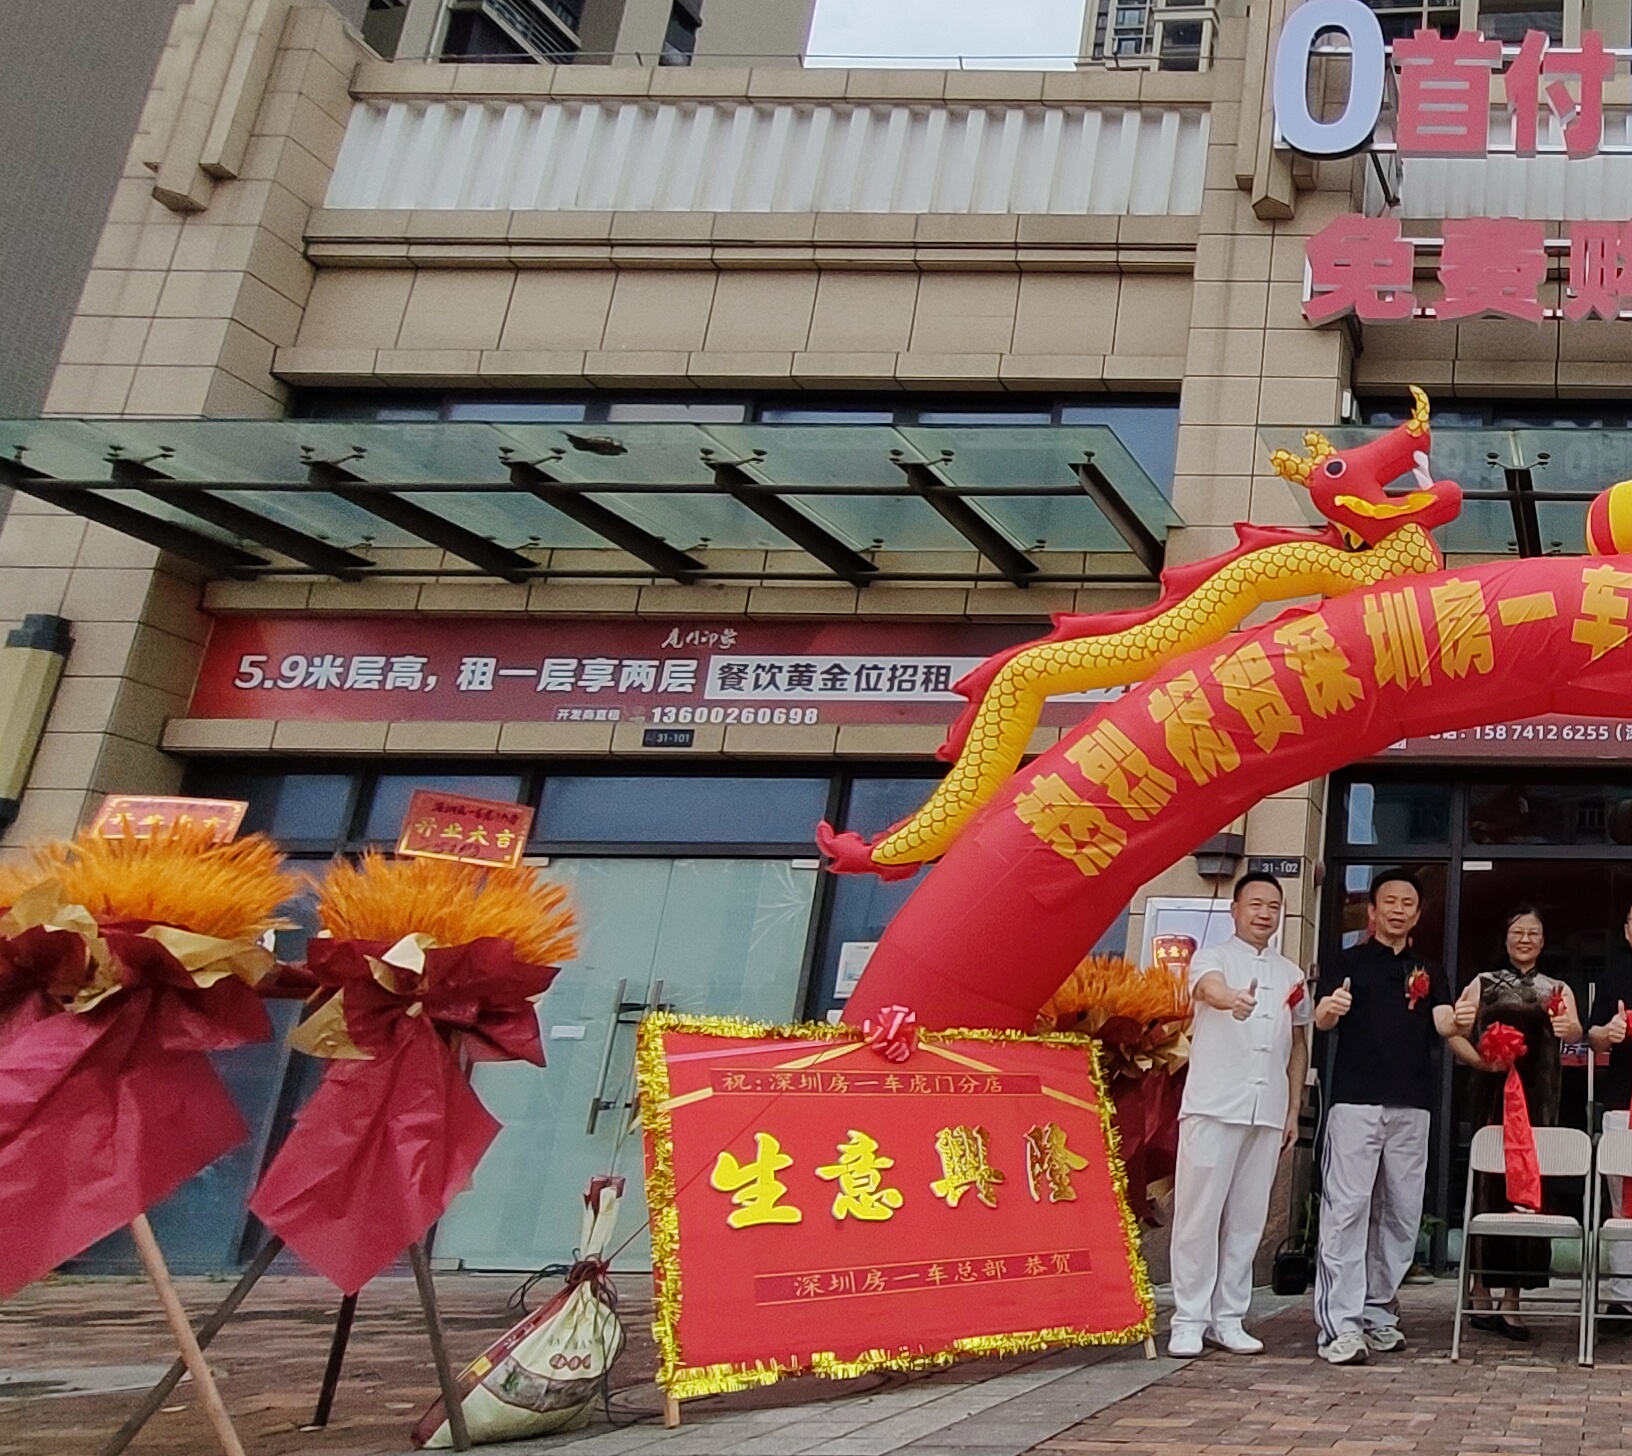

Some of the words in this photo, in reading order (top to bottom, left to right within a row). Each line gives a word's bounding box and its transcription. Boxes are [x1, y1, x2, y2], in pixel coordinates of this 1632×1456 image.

[717, 662, 953, 694] 餐饮黄金位招租
[652, 706, 818, 724] 13600260698
[656, 733, 690, 743] 31-101
[1474, 725, 1507, 739] 158
[1511, 725, 1558, 740] 7412
[1563, 725, 1609, 740] 6255
[414, 816, 516, 849] 开业大吉
[1261, 862, 1299, 874] 31-102
[793, 1258, 1007, 1297] 深圳房一车总部
[1023, 1251, 1072, 1277] 恭贺
